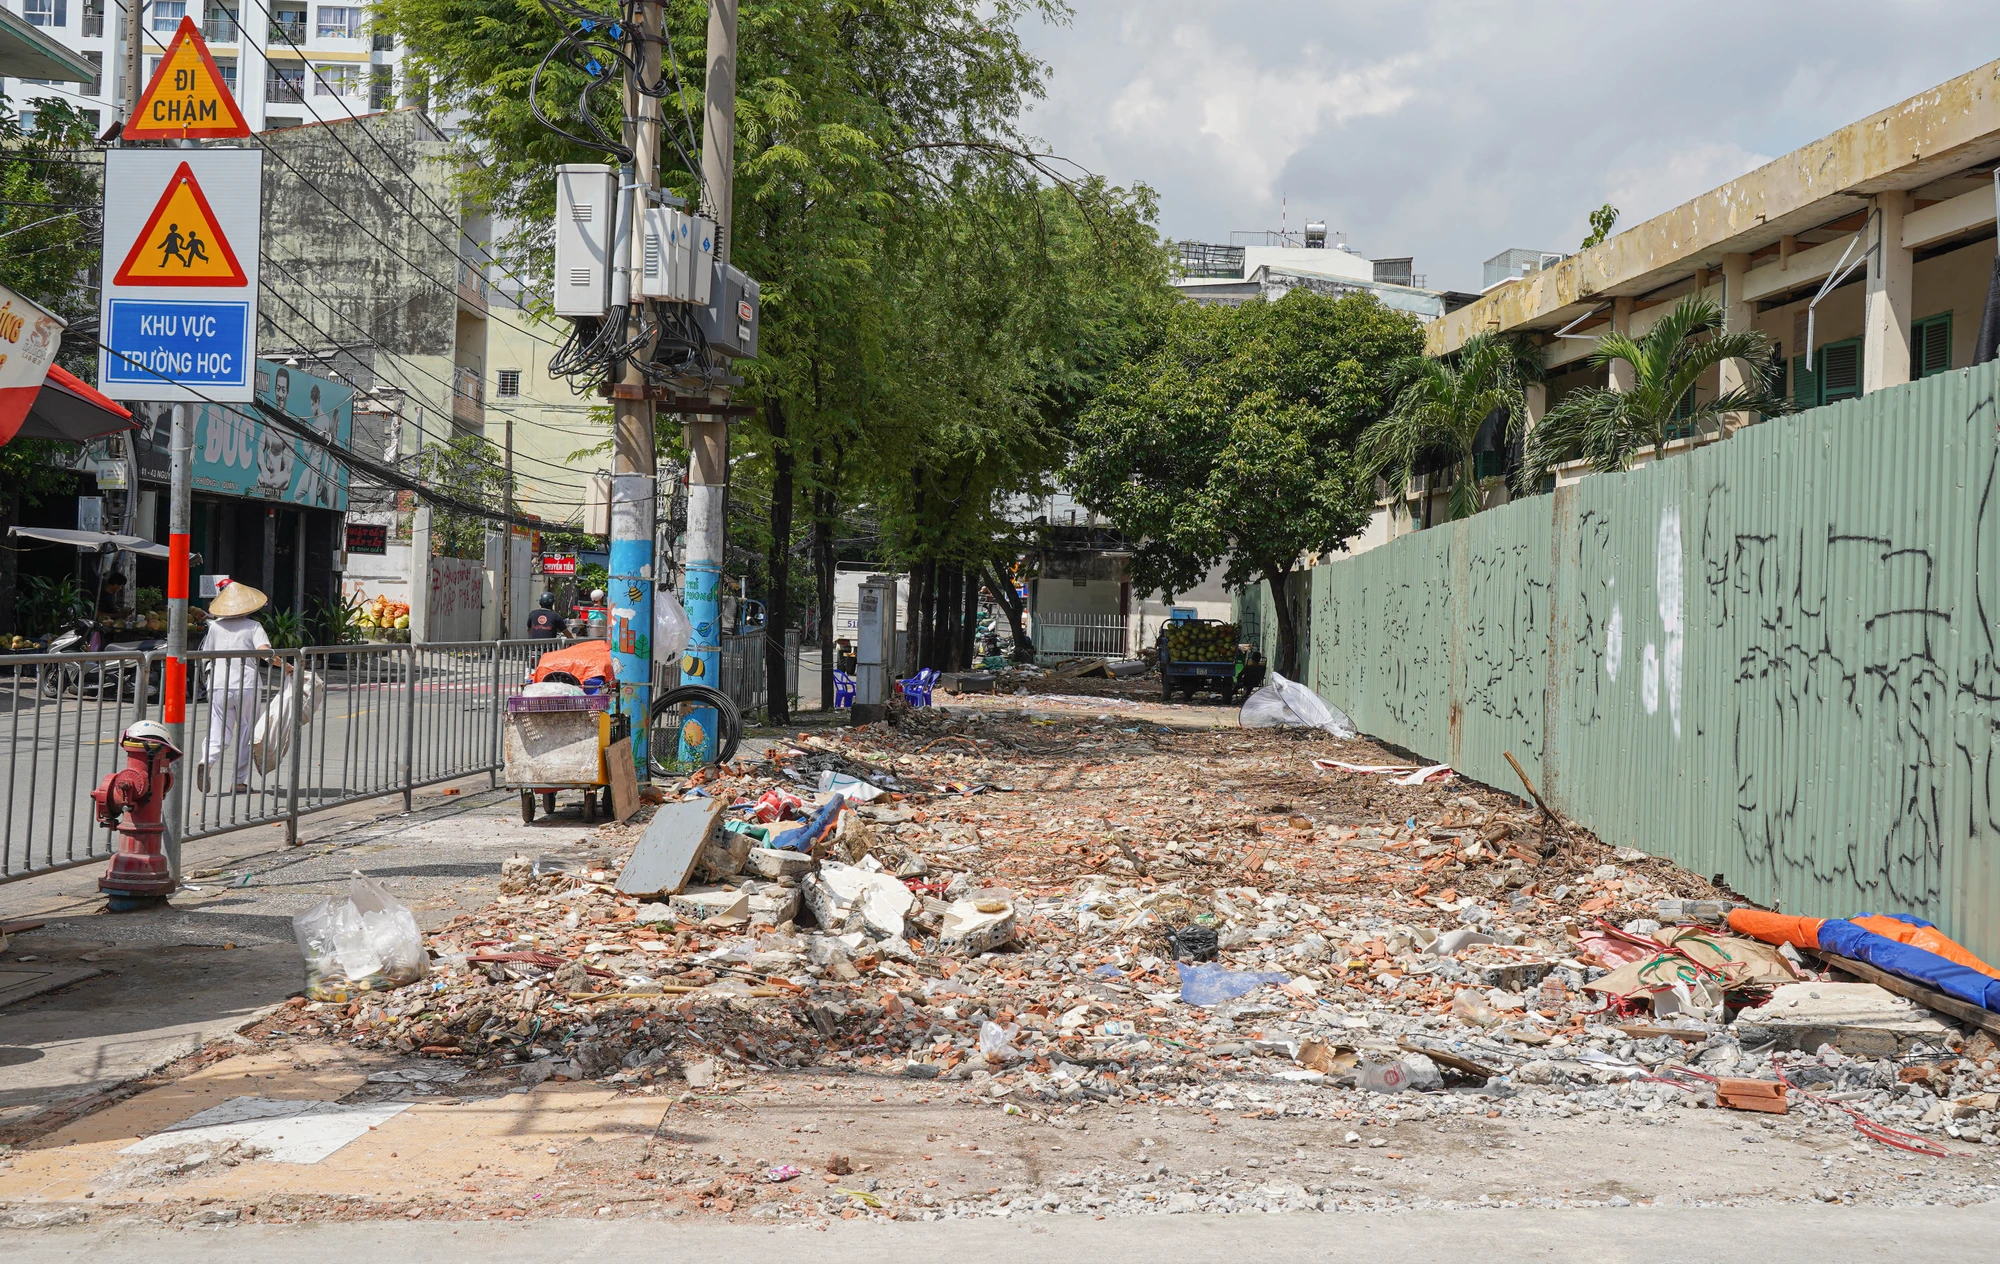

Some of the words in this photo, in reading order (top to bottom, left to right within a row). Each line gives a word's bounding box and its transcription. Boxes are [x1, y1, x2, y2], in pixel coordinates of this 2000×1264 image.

[174, 69, 195, 91] ĐI
[153, 96, 217, 125] CHẬM
[141, 314, 176, 336] KHU
[181, 315, 216, 343] VỰC
[121, 346, 192, 374] TRƯỜNG
[197, 352, 232, 380] HỌC
